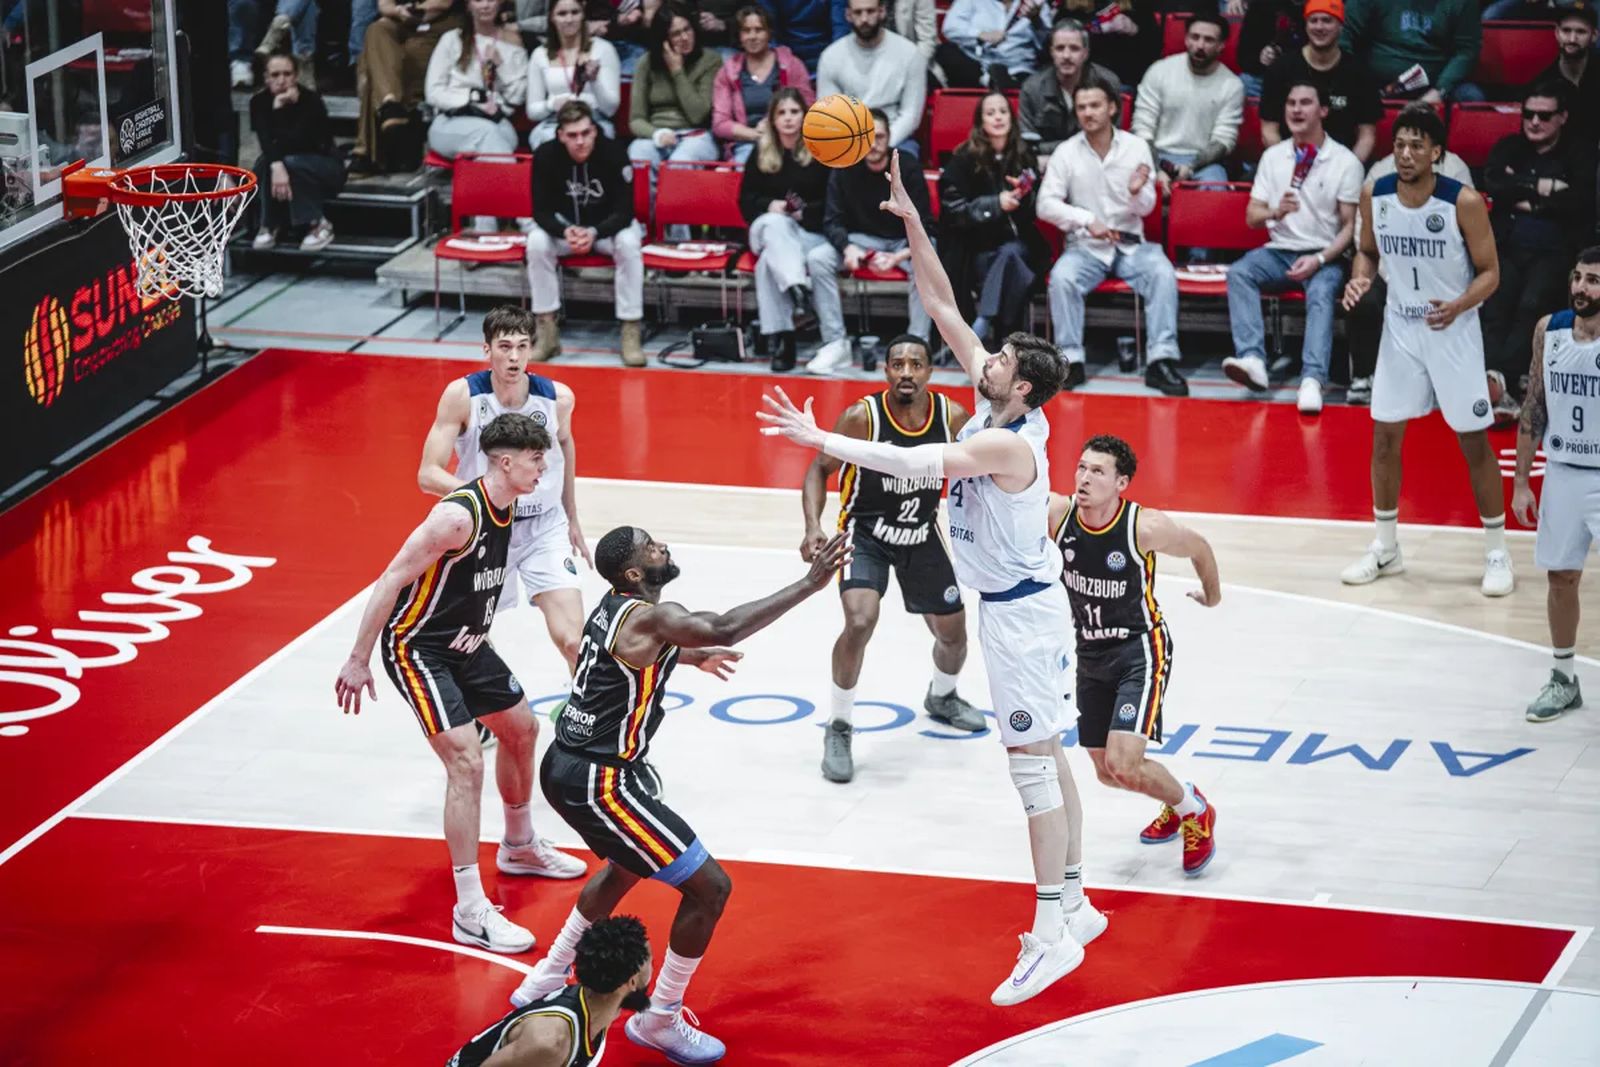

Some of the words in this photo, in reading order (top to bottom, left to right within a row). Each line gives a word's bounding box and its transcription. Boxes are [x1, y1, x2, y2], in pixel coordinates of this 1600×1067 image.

[1412, 267, 1420, 291] 1
[1550, 371, 1600, 398] JOVENT
[1572, 406, 1584, 433] 9
[1565, 442, 1600, 454] PROBIT
[950, 480, 963, 507] 4
[897, 497, 920, 523] 22
[1063, 569, 1127, 599] WÜRZBURG
[1084, 603, 1102, 628] 11
